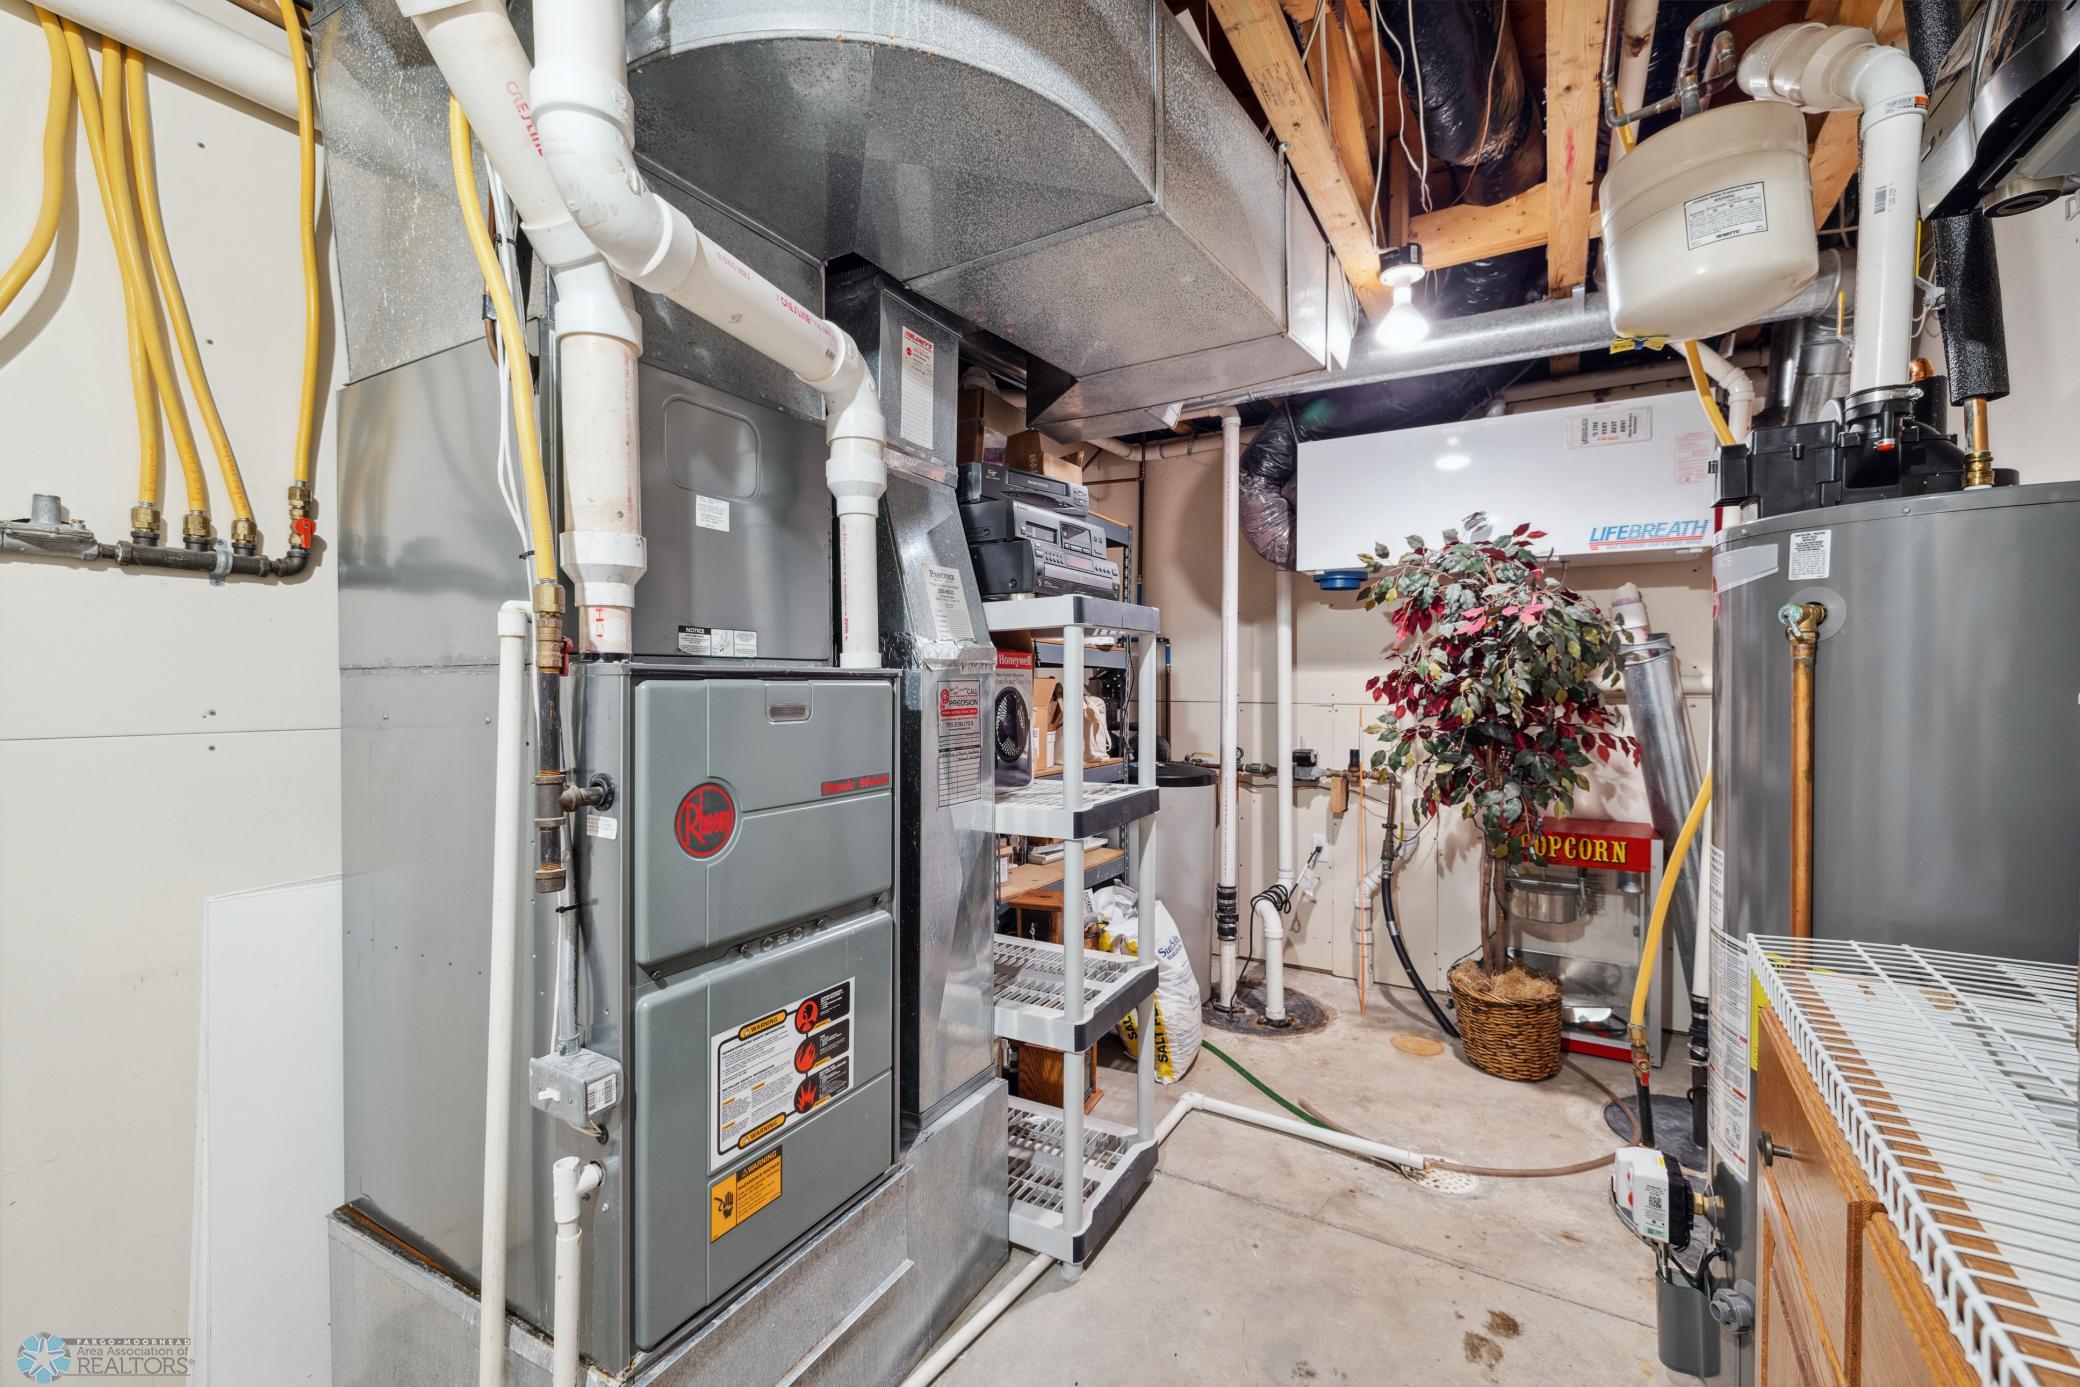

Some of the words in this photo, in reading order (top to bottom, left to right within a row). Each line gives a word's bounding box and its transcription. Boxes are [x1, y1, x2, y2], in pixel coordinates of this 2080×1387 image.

[1590, 519, 1709, 542] LIFEBREATH
[999, 654, 1032, 667] Honeywell
[685, 790, 731, 845] Rheem
[751, 1017, 778, 1032] WARNING
[750, 1120, 778, 1139] WARNING
[747, 1150, 777, 1172] WARNING
